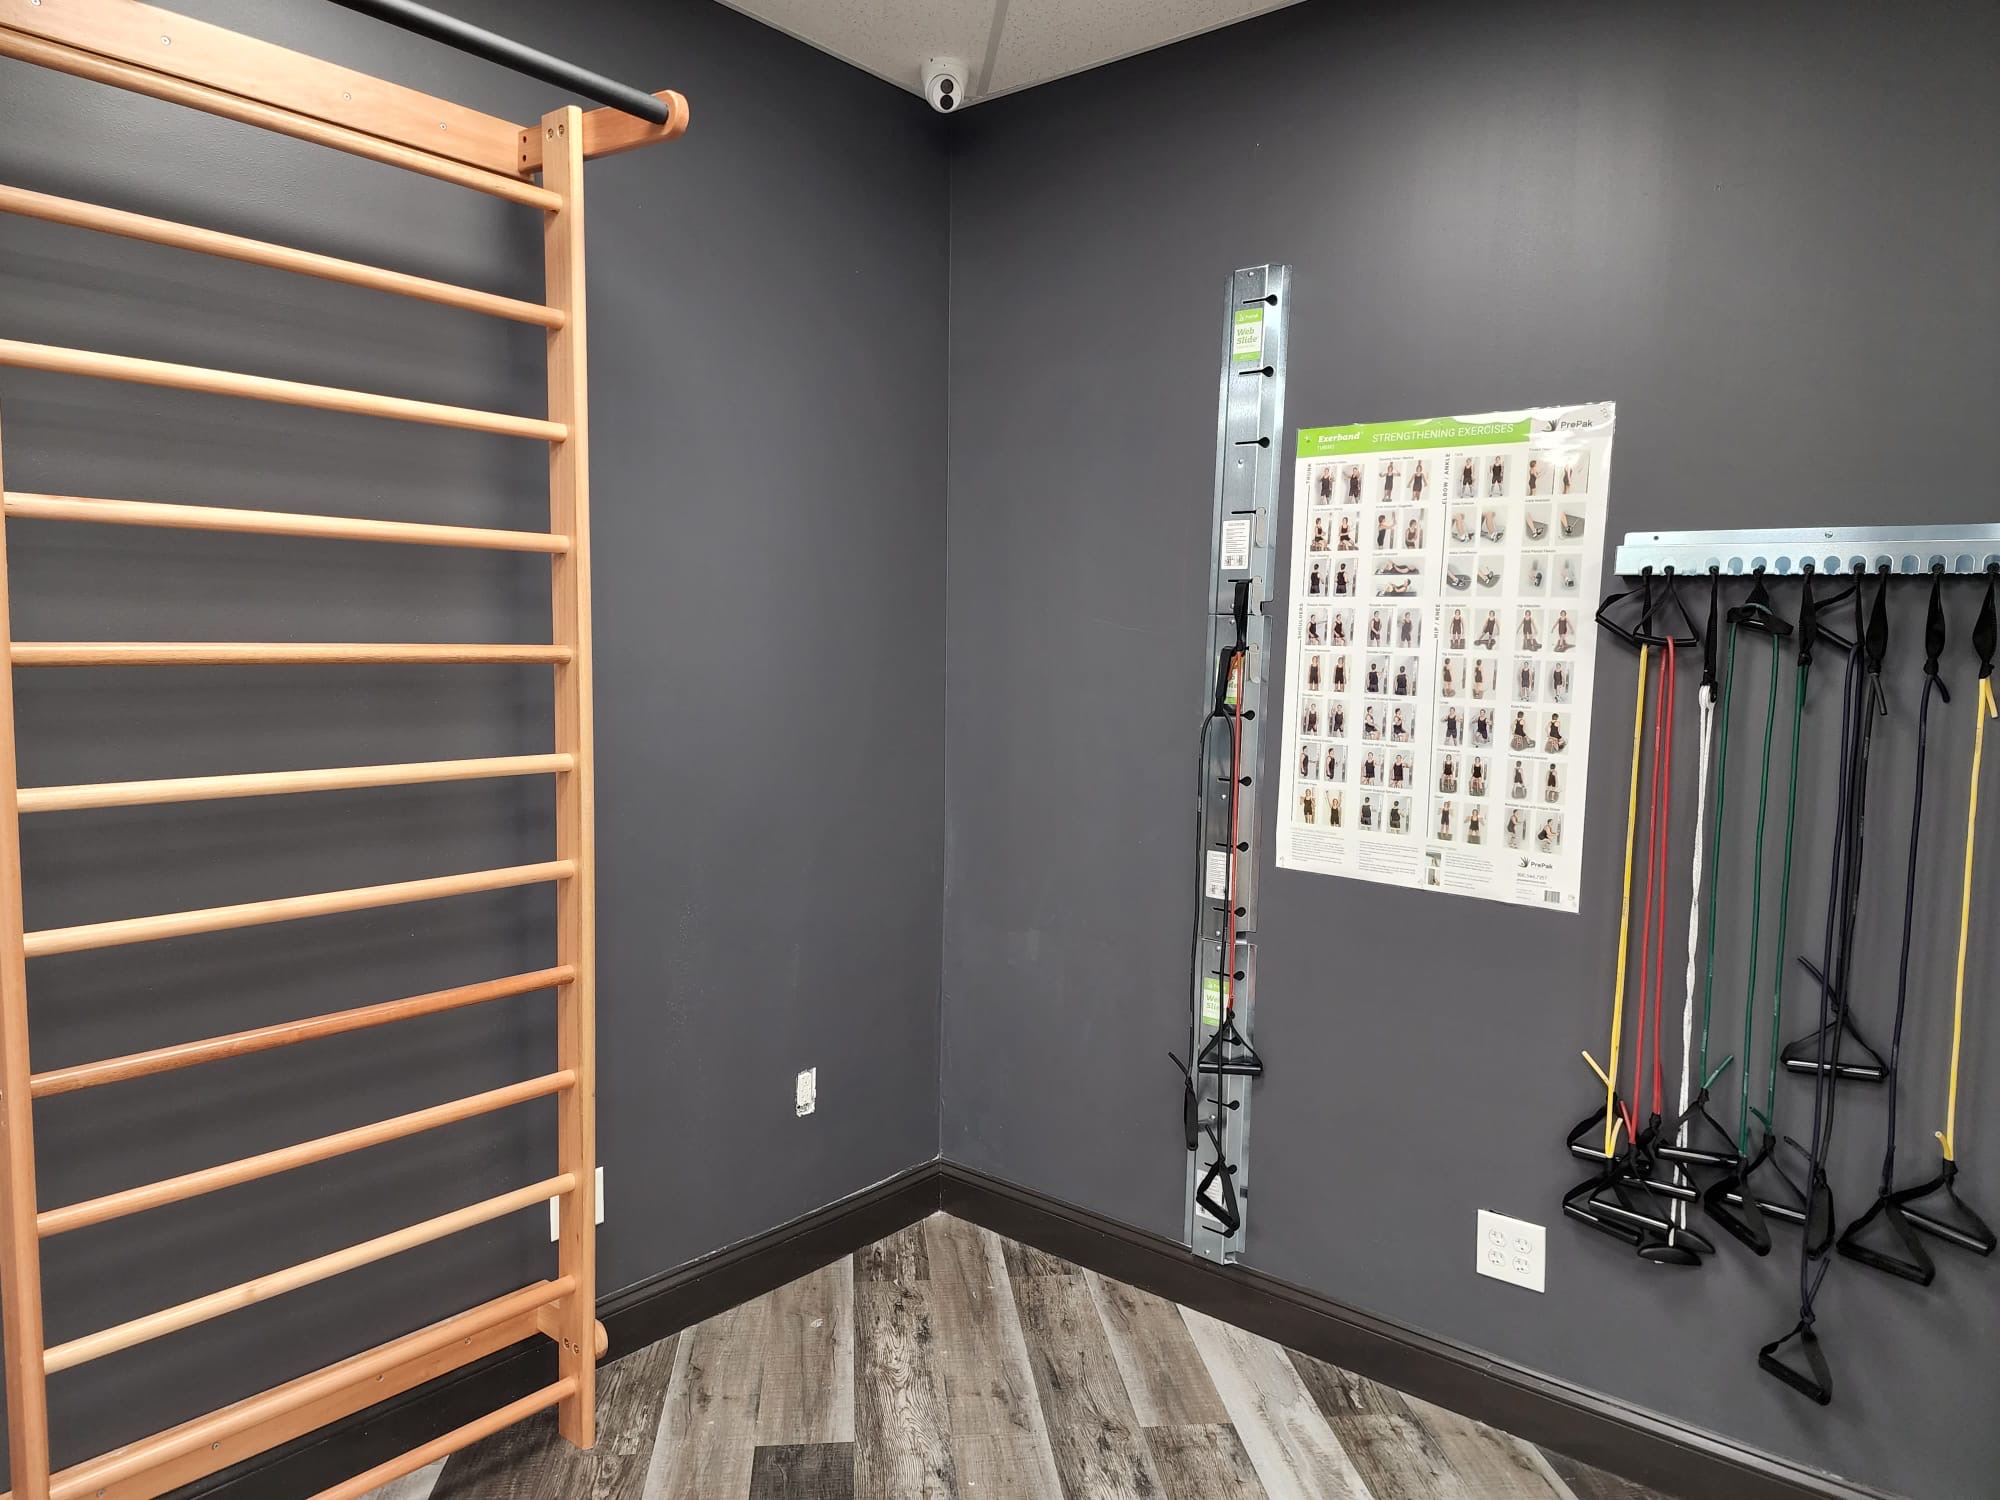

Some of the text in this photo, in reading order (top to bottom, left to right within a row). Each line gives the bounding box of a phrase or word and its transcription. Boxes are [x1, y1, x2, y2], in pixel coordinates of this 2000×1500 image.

[1237, 328, 1254, 336] Web
[1237, 336, 1257, 344] Slide
[1560, 419, 1593, 429] PrePak
[1318, 432, 1361, 443] Exerband
[1372, 423, 1514, 443] STRENGTHENING EXERCISES
